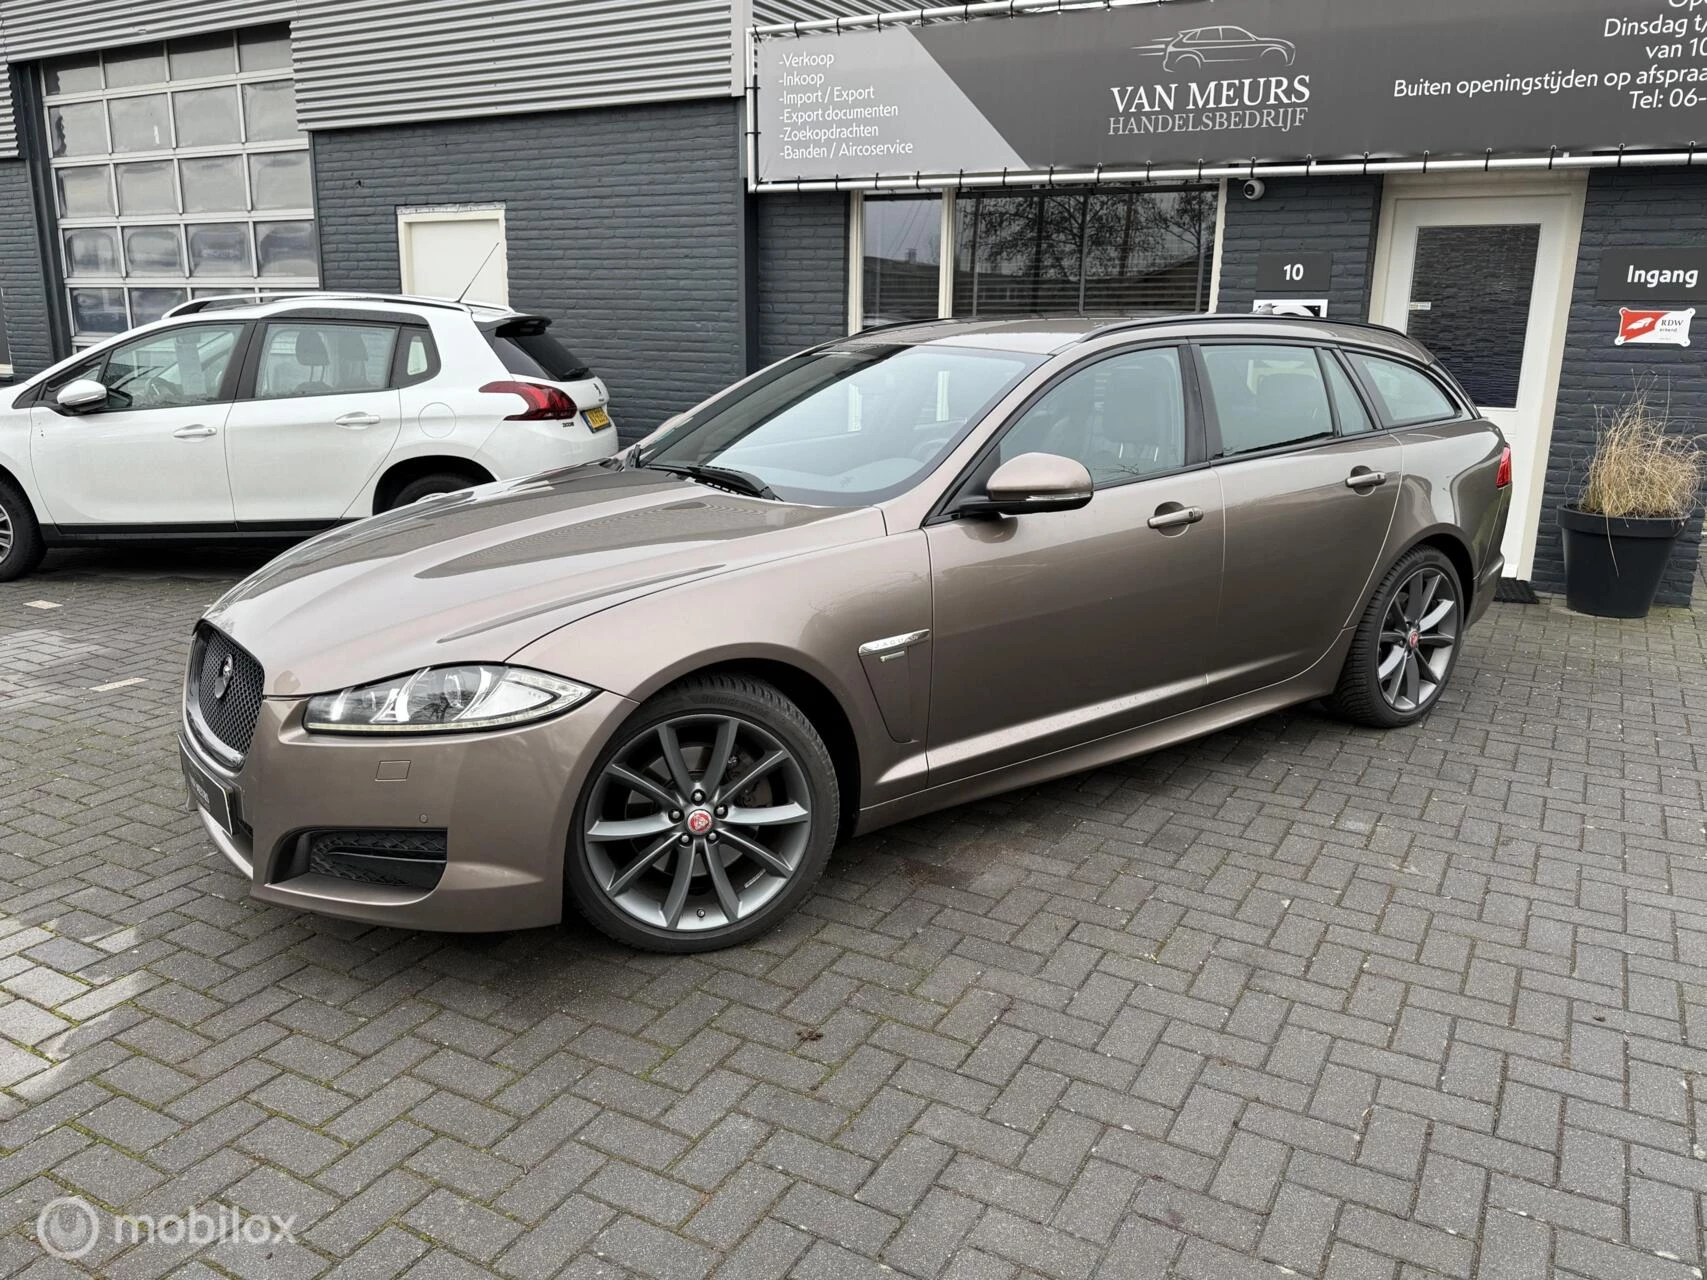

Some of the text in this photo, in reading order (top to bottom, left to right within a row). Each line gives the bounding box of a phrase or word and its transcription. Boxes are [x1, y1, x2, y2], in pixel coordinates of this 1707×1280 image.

[1604, 14, 1688, 38] Dinsdag
[779, 51, 835, 68] -Verkoop
[1645, 43, 1682, 59] van
[778, 71, 825, 88] -Inkoop
[1393, 64, 1707, 98] Buiten openingstijden op afspraa
[779, 85, 875, 108] -Import / Export
[1110, 74, 1311, 113] VAN MEURS
[1628, 88, 1707, 110] Tel: 06-
[779, 104, 899, 126] -Export documenten
[1108, 107, 1309, 135] HANDELSBEDRIJF
[779, 122, 880, 143] -Zoekopdrachten
[780, 139, 914, 160] -Banden / Aircoservice
[1283, 263, 1305, 281] 10
[1627, 264, 1699, 288] Ingang
[1661, 319, 1684, 328] RDW
